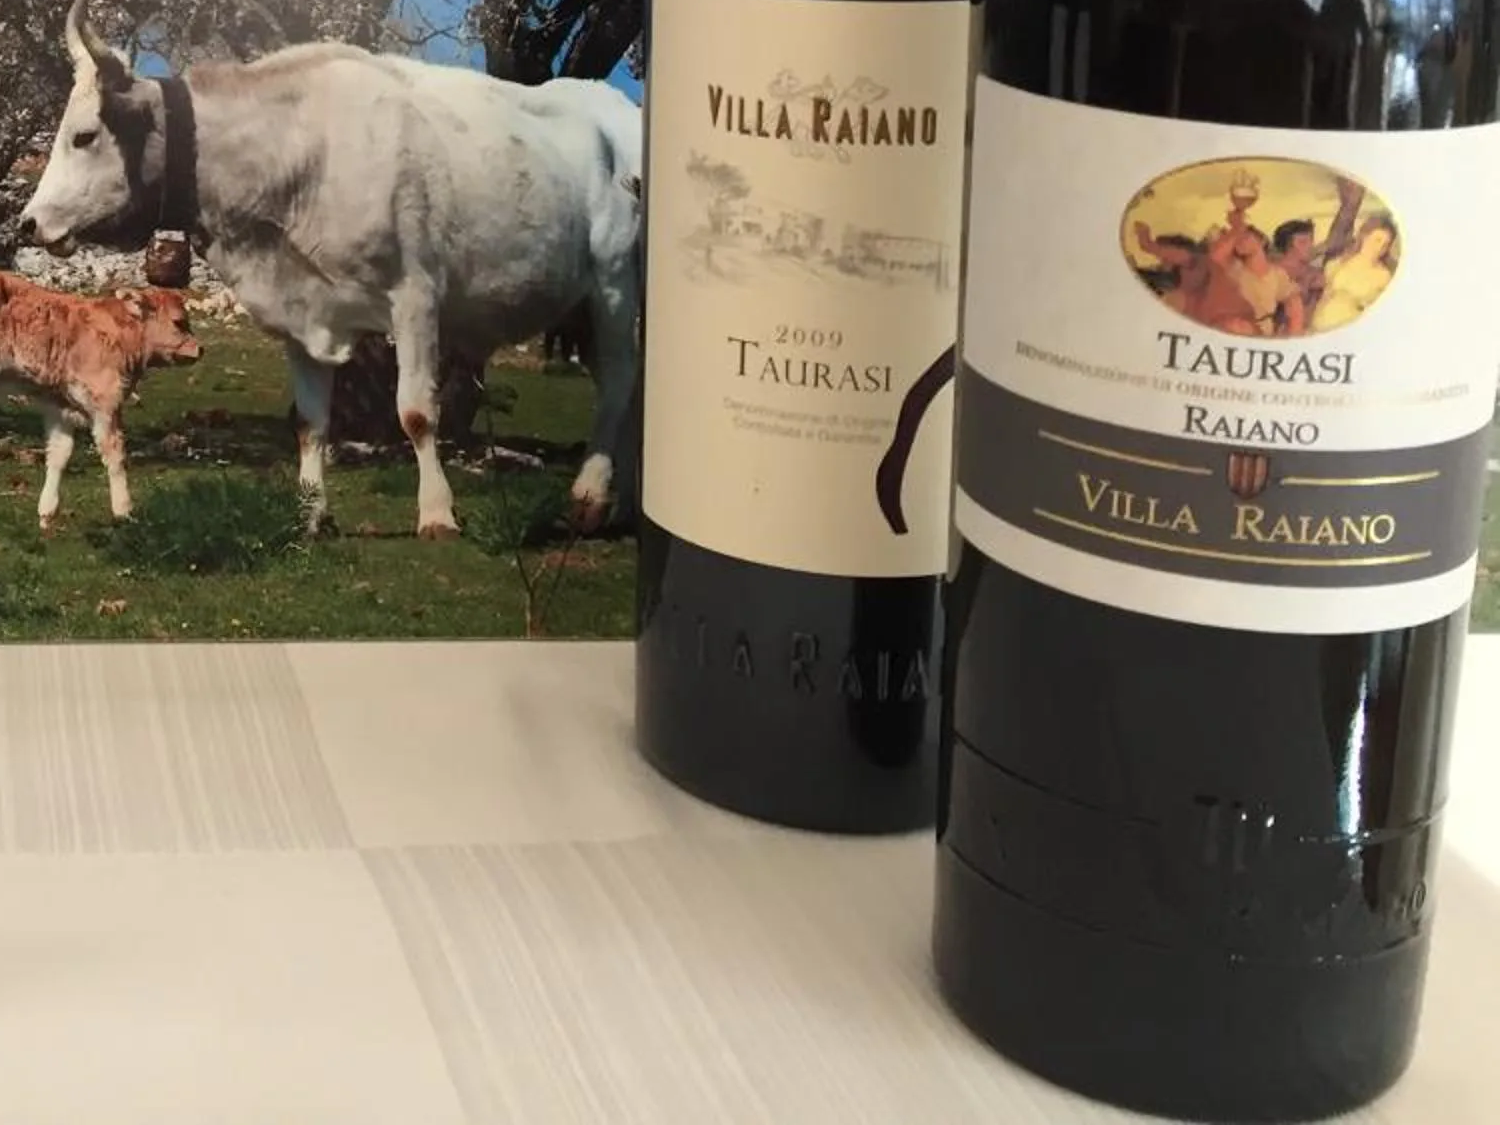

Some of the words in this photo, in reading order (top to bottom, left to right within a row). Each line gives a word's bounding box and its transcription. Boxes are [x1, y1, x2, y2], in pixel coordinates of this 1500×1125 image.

[706, 84, 793, 141] VILLA
[810, 98, 939, 147] RAIANO
[727, 335, 892, 393] TAURASI
[775, 325, 844, 349] 2009
[1157, 330, 1357, 385] TAURASI
[1184, 404, 1320, 446] RAIANO
[1076, 472, 1200, 535] VILLA
[1231, 505, 1397, 547] RAIANO
